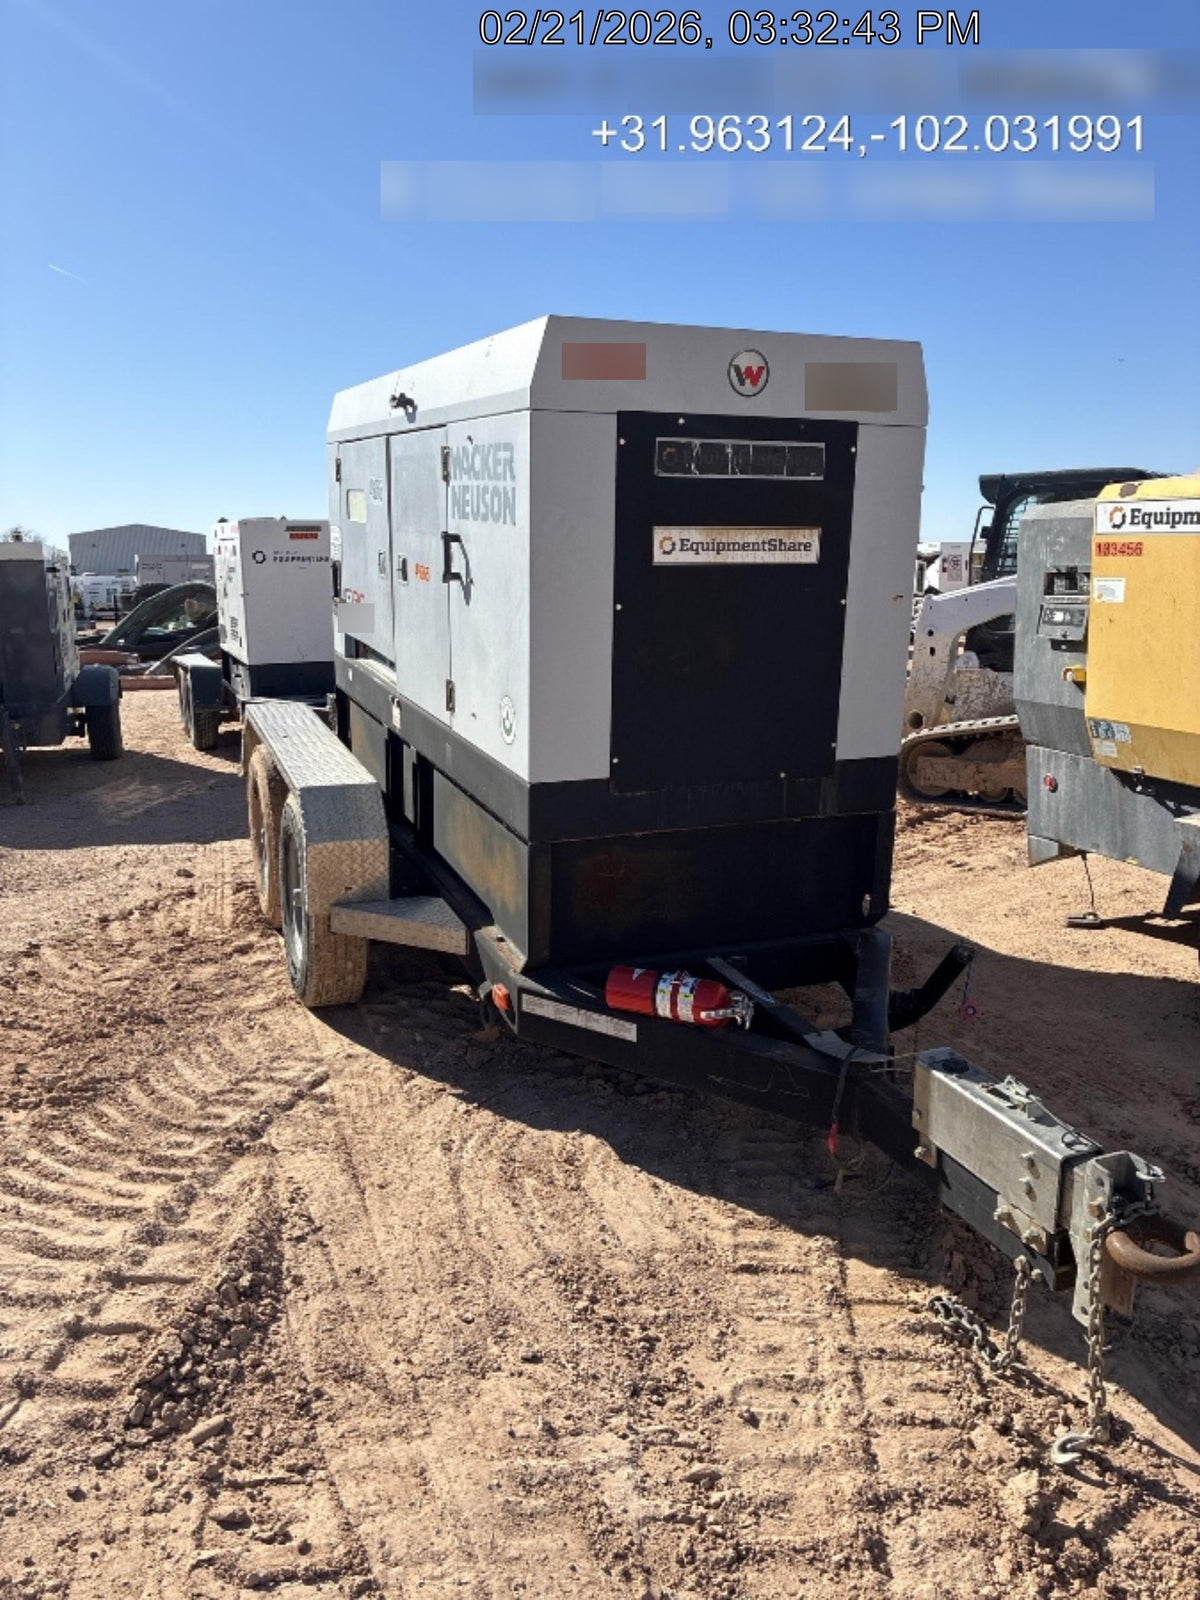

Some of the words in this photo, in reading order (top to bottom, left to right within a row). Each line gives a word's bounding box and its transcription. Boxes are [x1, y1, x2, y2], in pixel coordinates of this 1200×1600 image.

[451, 441, 516, 482] WACKER
[451, 484, 516, 526] NEUSON
[679, 537, 813, 555] EquipmentShare
